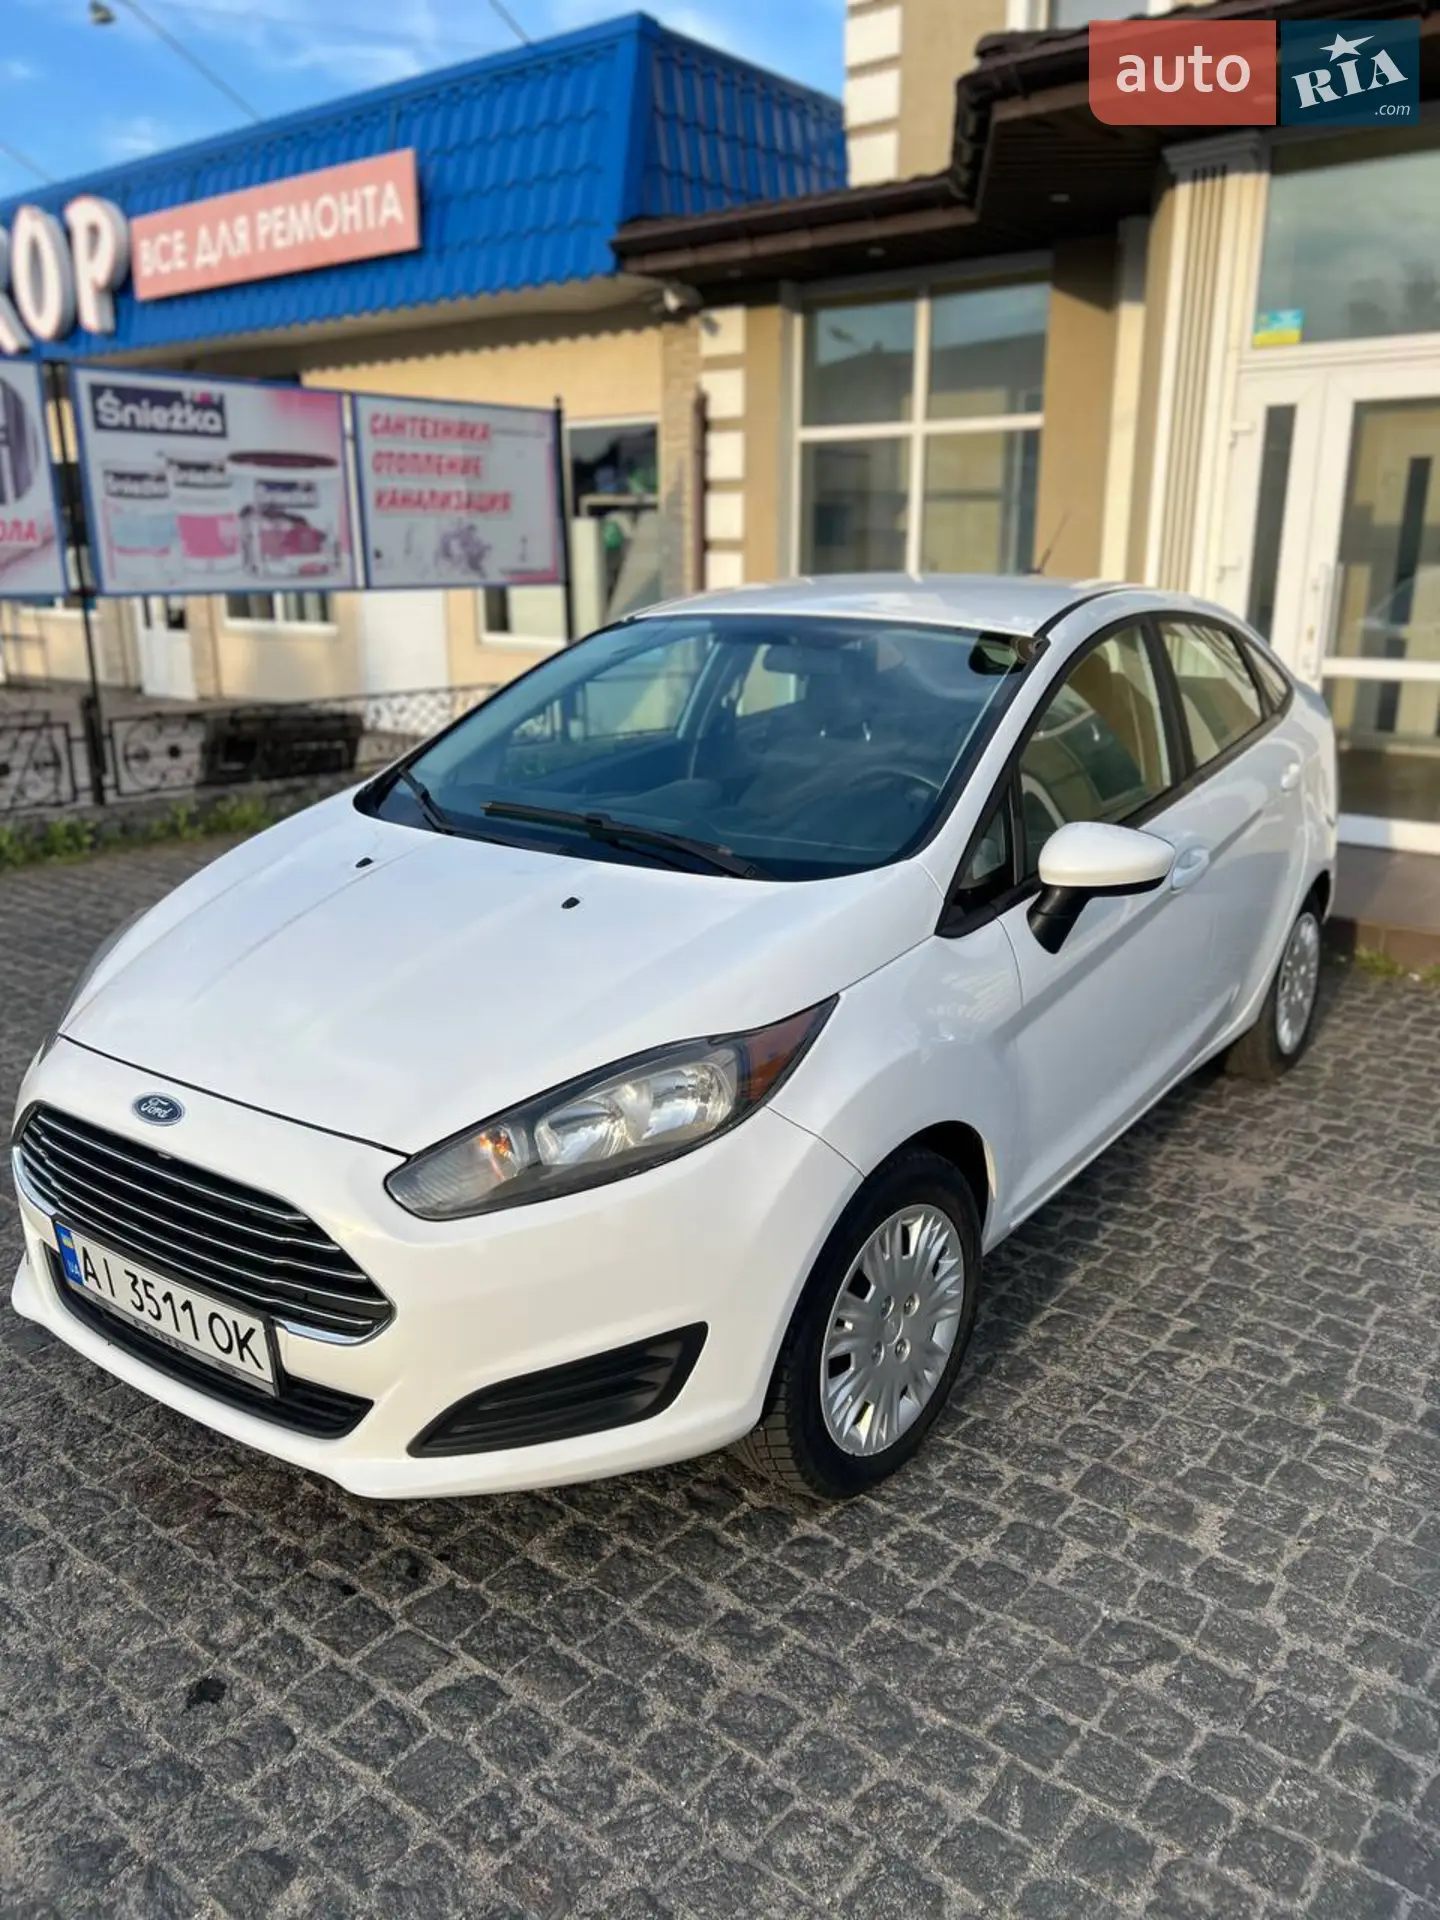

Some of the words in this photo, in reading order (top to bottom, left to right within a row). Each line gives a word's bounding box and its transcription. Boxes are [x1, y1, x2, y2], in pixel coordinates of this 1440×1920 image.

[138, 229, 188, 278] ВСЕ
[194, 214, 251, 270] ДЛЯ
[256, 180, 404, 253] РЕМОНТА
[96, 389, 223, 434] Śnieżka
[370, 412, 491, 441] САНТЕХНИКА
[372, 449, 482, 478] ОТОПЛЕНИЕ
[375, 487, 511, 513] КАНАЛИЗАЦИЯ
[140, 1097, 173, 1118] Ford
[67, 1259, 80, 1276] UA
[82, 1246, 116, 1298] AI
[124, 1269, 200, 1342] 3511
[208, 1311, 264, 1371] OK
